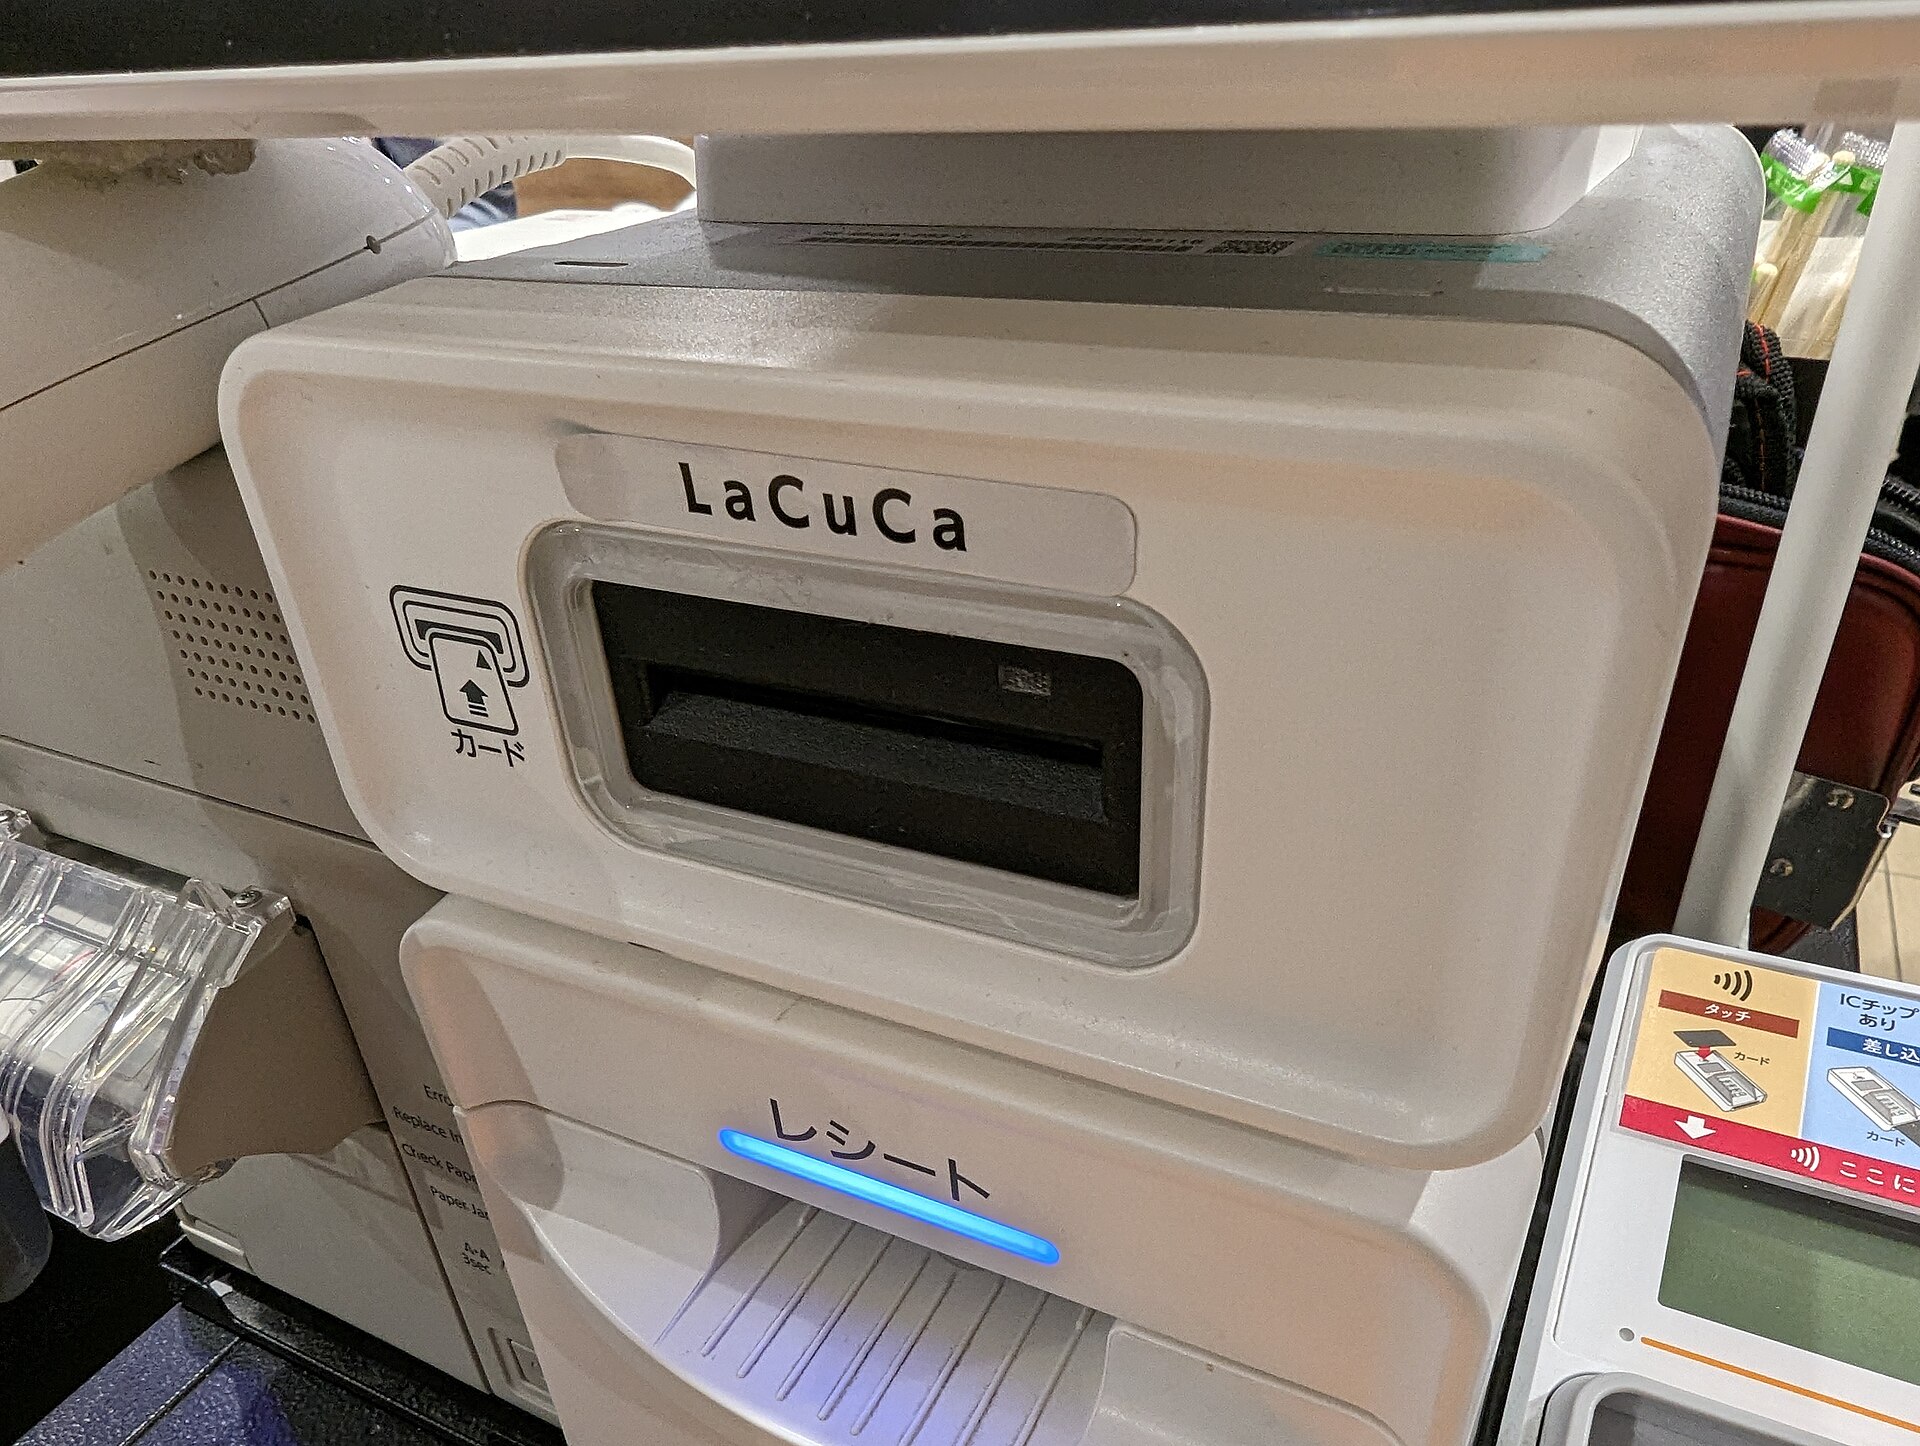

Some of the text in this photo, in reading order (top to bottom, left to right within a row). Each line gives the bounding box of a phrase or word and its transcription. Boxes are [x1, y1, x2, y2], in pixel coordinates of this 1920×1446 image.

[678, 461, 969, 552] LaCuCa
[450, 728, 526, 767] カード
[1704, 1003, 1751, 1022] タッチ
[1840, 993, 1920, 1019] ICチップ
[1859, 1013, 1895, 1031] あり
[1734, 1051, 1770, 1066] カード
[393, 1105, 448, 1139] Replace
[769, 1097, 990, 1202] レシート
[1866, 1130, 1906, 1147] カード
[401, 1143, 444, 1169] Check
[1840, 1161, 1917, 1193] ここに
[429, 1185, 468, 1210] Paper
